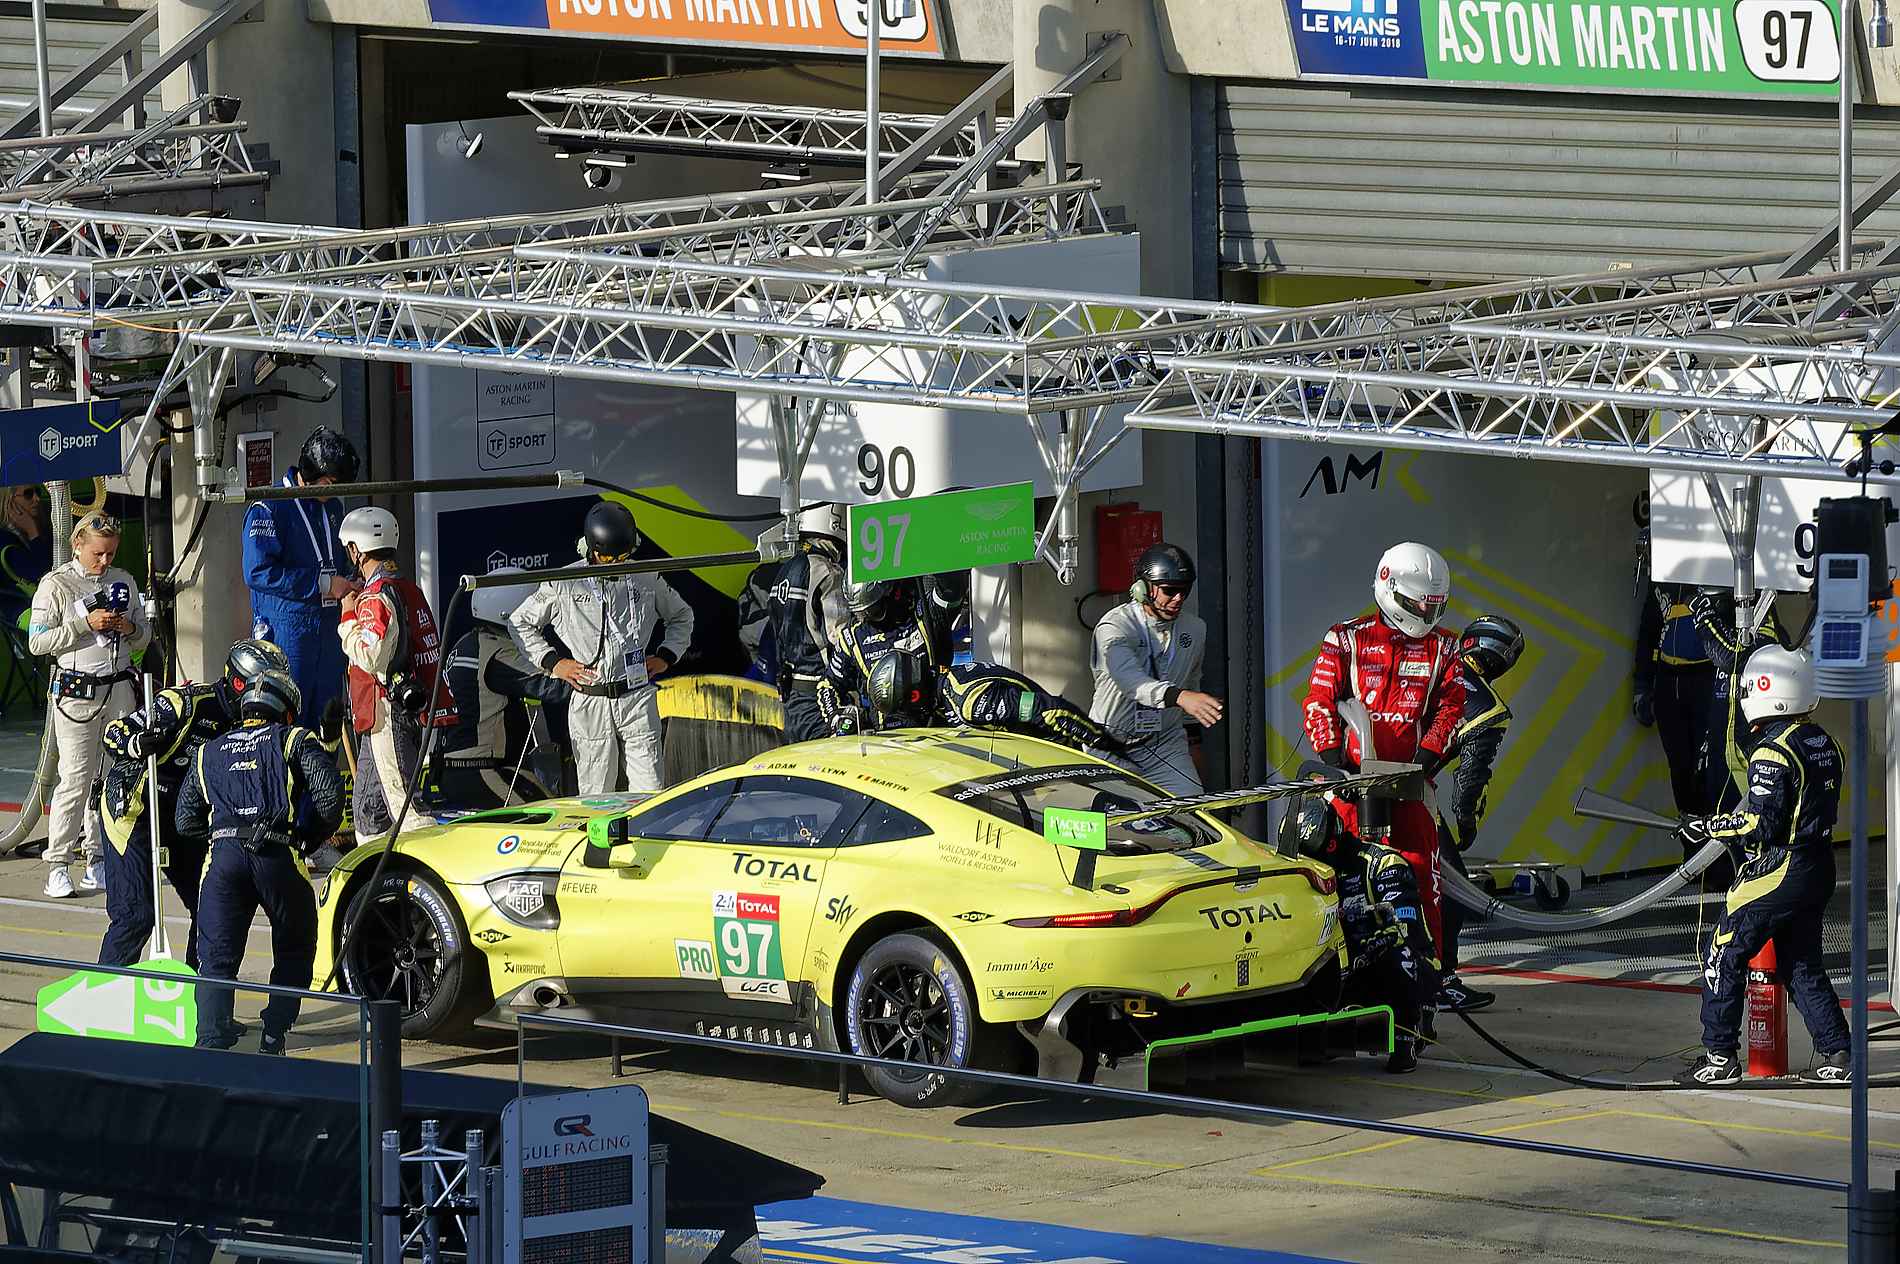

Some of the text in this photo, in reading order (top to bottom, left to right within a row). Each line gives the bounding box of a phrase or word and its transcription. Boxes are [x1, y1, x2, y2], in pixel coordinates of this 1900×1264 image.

[1302, 13, 1401, 37] LE MANS
[1334, 34, 1401, 49] 16-17 JUIN 2018
[1438, 0, 1727, 73] ASTON MARTIN
[1762, 9, 1813, 70] 97
[485, 379, 546, 396] ASTON MARTIN
[500, 394, 531, 407] RACING
[806, 400, 858, 418] RCING
[43, 434, 98, 451] TF SPORT
[489, 433, 547, 452] TF SPORT
[857, 443, 916, 499] 90
[859, 512, 911, 570] 97
[959, 526, 1028, 544] ASTON MARTIN
[975, 542, 1011, 554] RACING
[509, 552, 549, 569] SPORT
[767, 762, 797, 770] ADAM
[820, 766, 848, 777] LYNN
[1755, 763, 1779, 774] HACKETT
[869, 777, 910, 793] MARTIN
[1050, 815, 1098, 833] HACKETT
[938, 841, 1017, 868] WALDORF ASTORIA
[732, 852, 818, 883] TOTAL
[509, 882, 540, 896] TAG
[561, 882, 598, 894] #FEVER
[506, 896, 542, 913] HEUER
[738, 898, 777, 914] TOTAL
[421, 892, 453, 942] MICHELIN
[961, 913, 988, 921] DOW
[1199, 902, 1292, 930] TOTAL
[480, 931, 504, 942] DOW
[721, 919, 773, 977] 97
[678, 945, 713, 974] PRO
[740, 981, 779, 995] WEC
[1006, 989, 1048, 998] MICHELIN
[522, 1134, 631, 1161] GULF RACING
